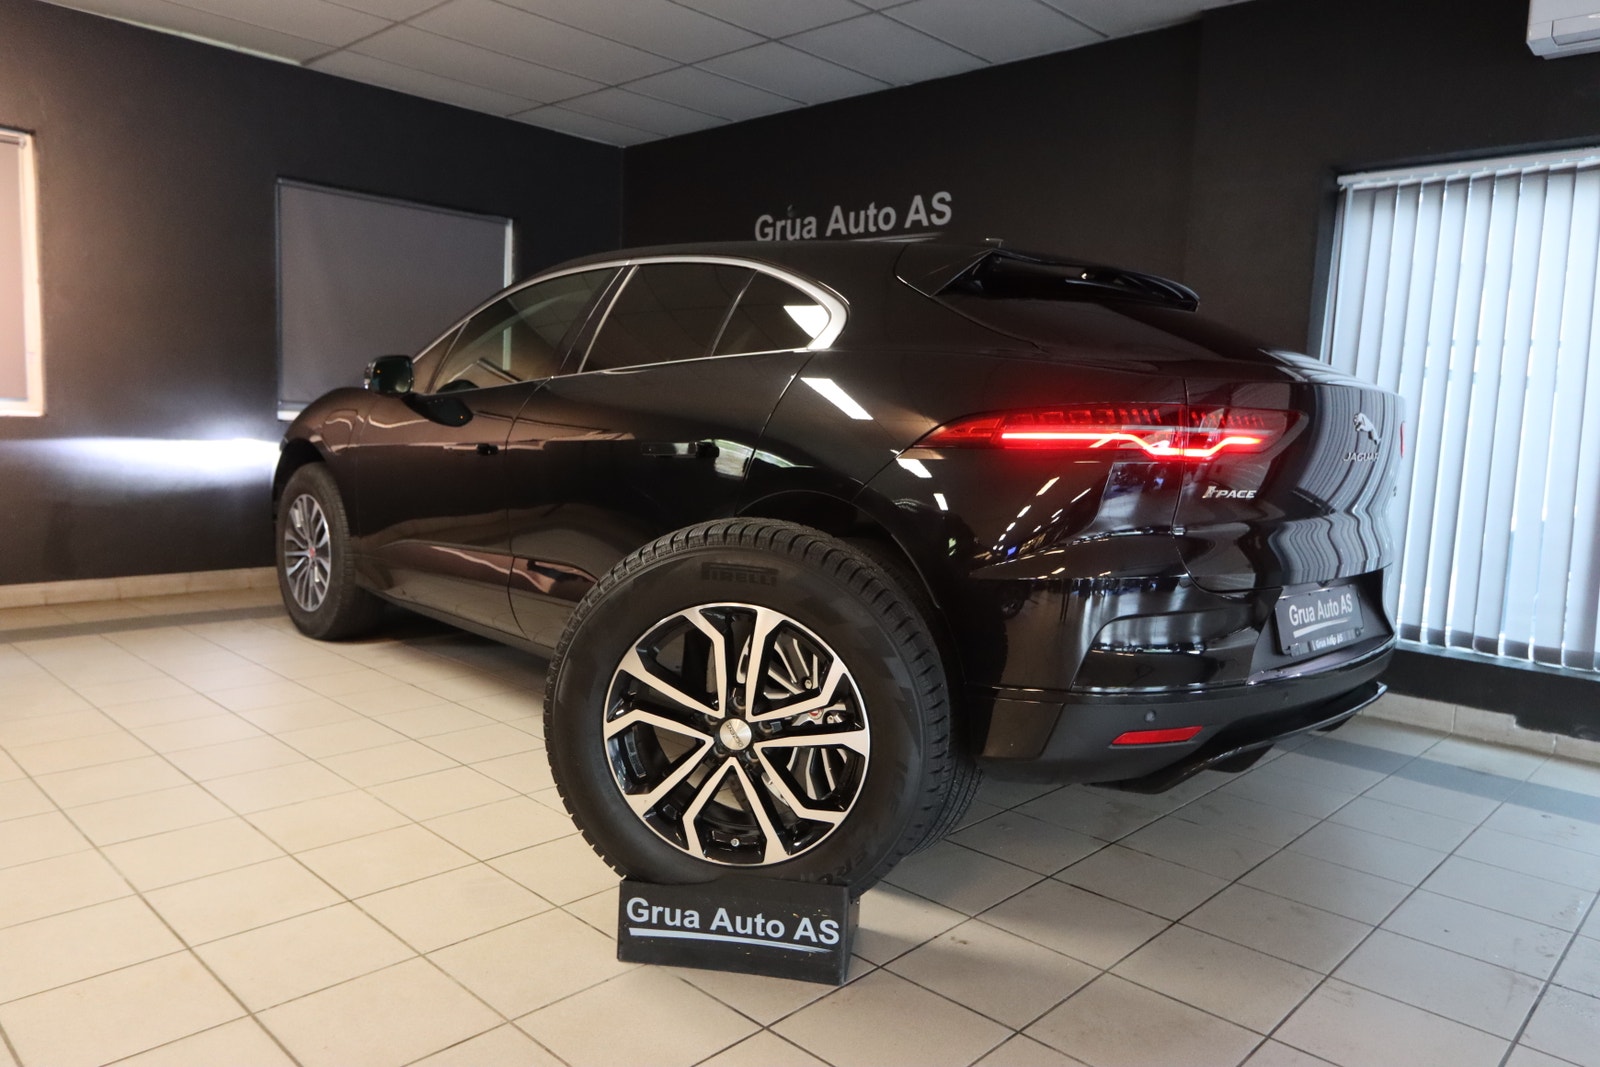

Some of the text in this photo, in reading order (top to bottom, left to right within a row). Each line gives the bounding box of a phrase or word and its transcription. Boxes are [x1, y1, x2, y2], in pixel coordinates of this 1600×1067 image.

[754, 191, 953, 241] Grua Auto AS
[702, 563, 780, 587] PIRELLI
[1288, 593, 1353, 626] Grua Auto AS
[626, 897, 840, 945] Grua Auto AS
